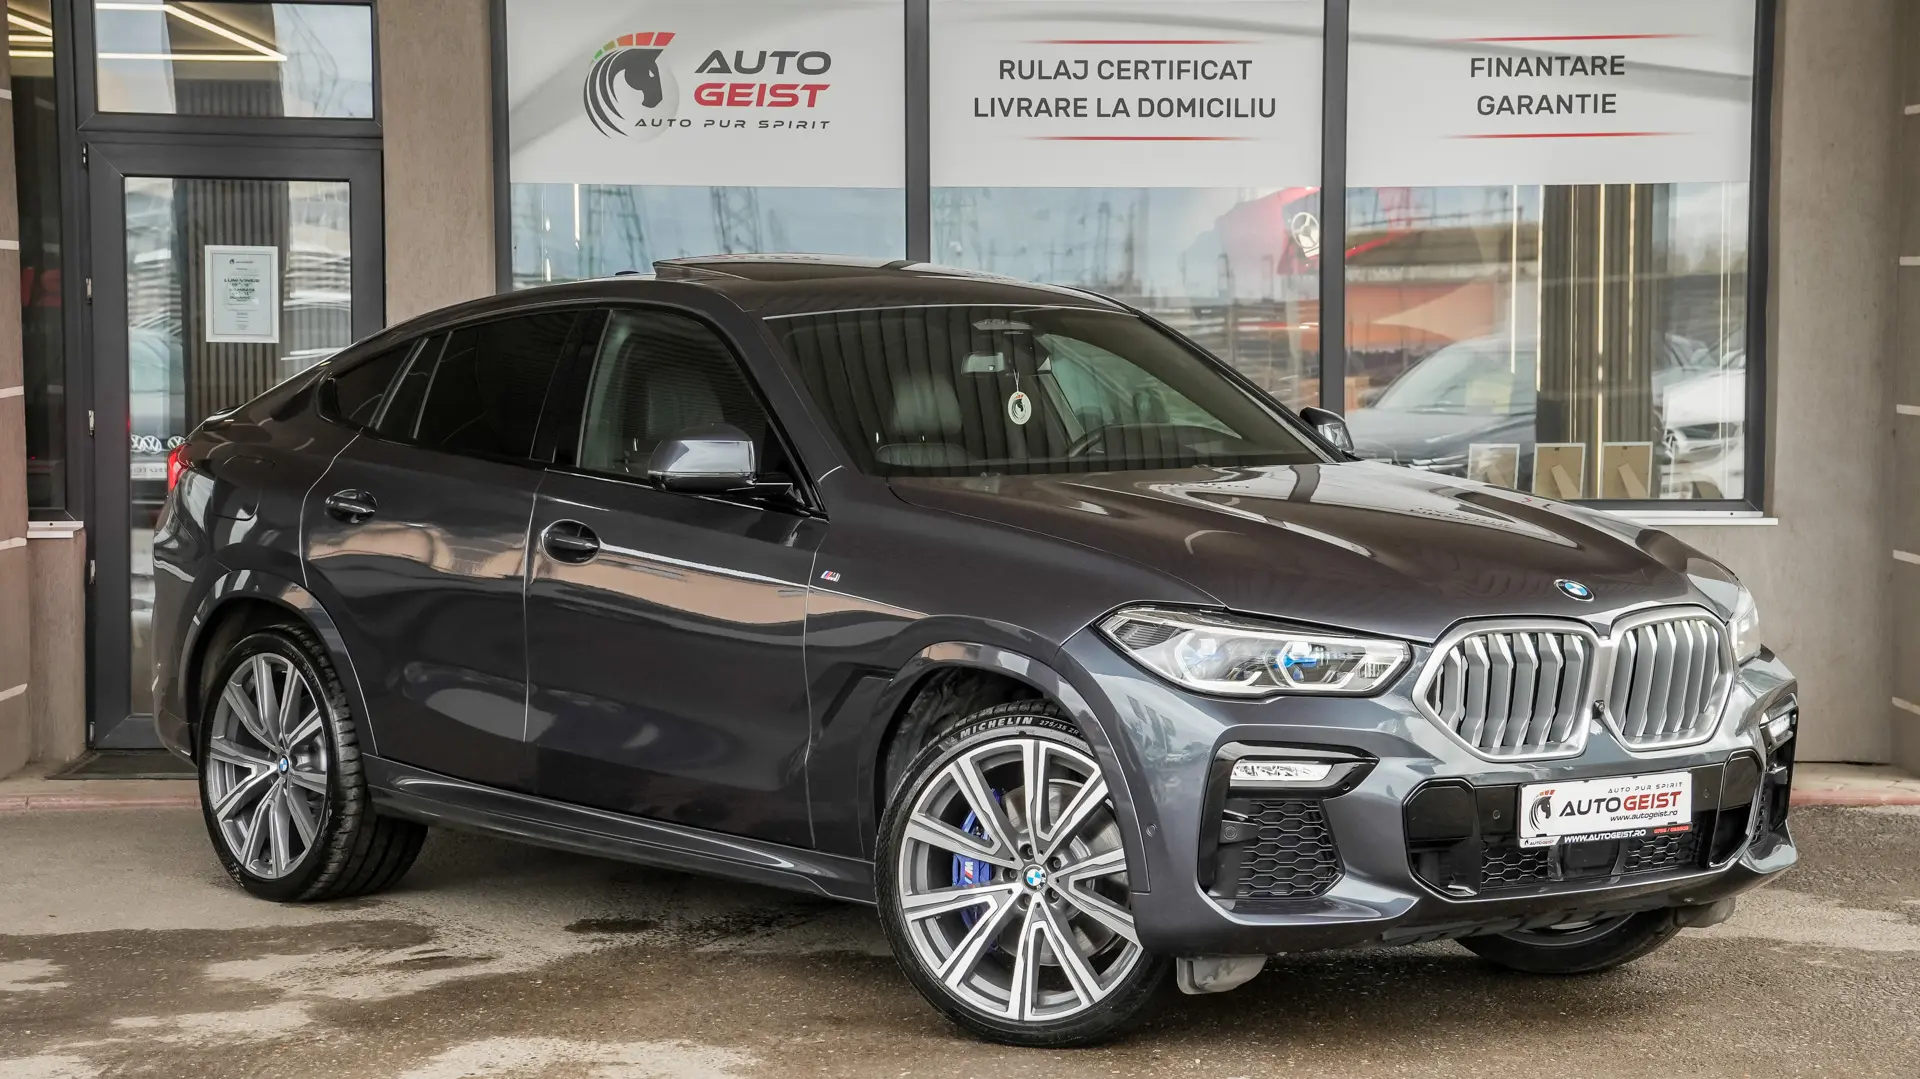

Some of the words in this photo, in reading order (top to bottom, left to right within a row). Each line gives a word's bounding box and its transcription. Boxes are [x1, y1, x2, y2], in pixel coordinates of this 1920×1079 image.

[694, 50, 832, 75] AUTO
[998, 59, 1089, 80] RULAJ
[1096, 59, 1253, 80] CERTIFICAT
[1470, 55, 1626, 78] FINANTARE
[693, 82, 831, 108] GEIST
[1477, 93, 1617, 116] GARANTIE
[973, 97, 1088, 118] LIVRARE
[1096, 97, 1131, 118] LA
[1137, 97, 1276, 118] DOMICILIU
[634, 118, 692, 128] AUTO
[703, 119, 747, 129] PUR
[758, 120, 831, 130] SPIRIT
[960, 716, 1034, 739] MICHELIN
[1039, 719, 1068, 731] 275/35
[1607, 786, 1631, 794] AUTO
[1655, 781, 1683, 790] SPIRIT
[1558, 790, 1682, 818] AUTOGEIST
[1610, 809, 1678, 822] www.autogeist.ro
[1563, 829, 1647, 844] WWW.AUTOGEIST.RO
